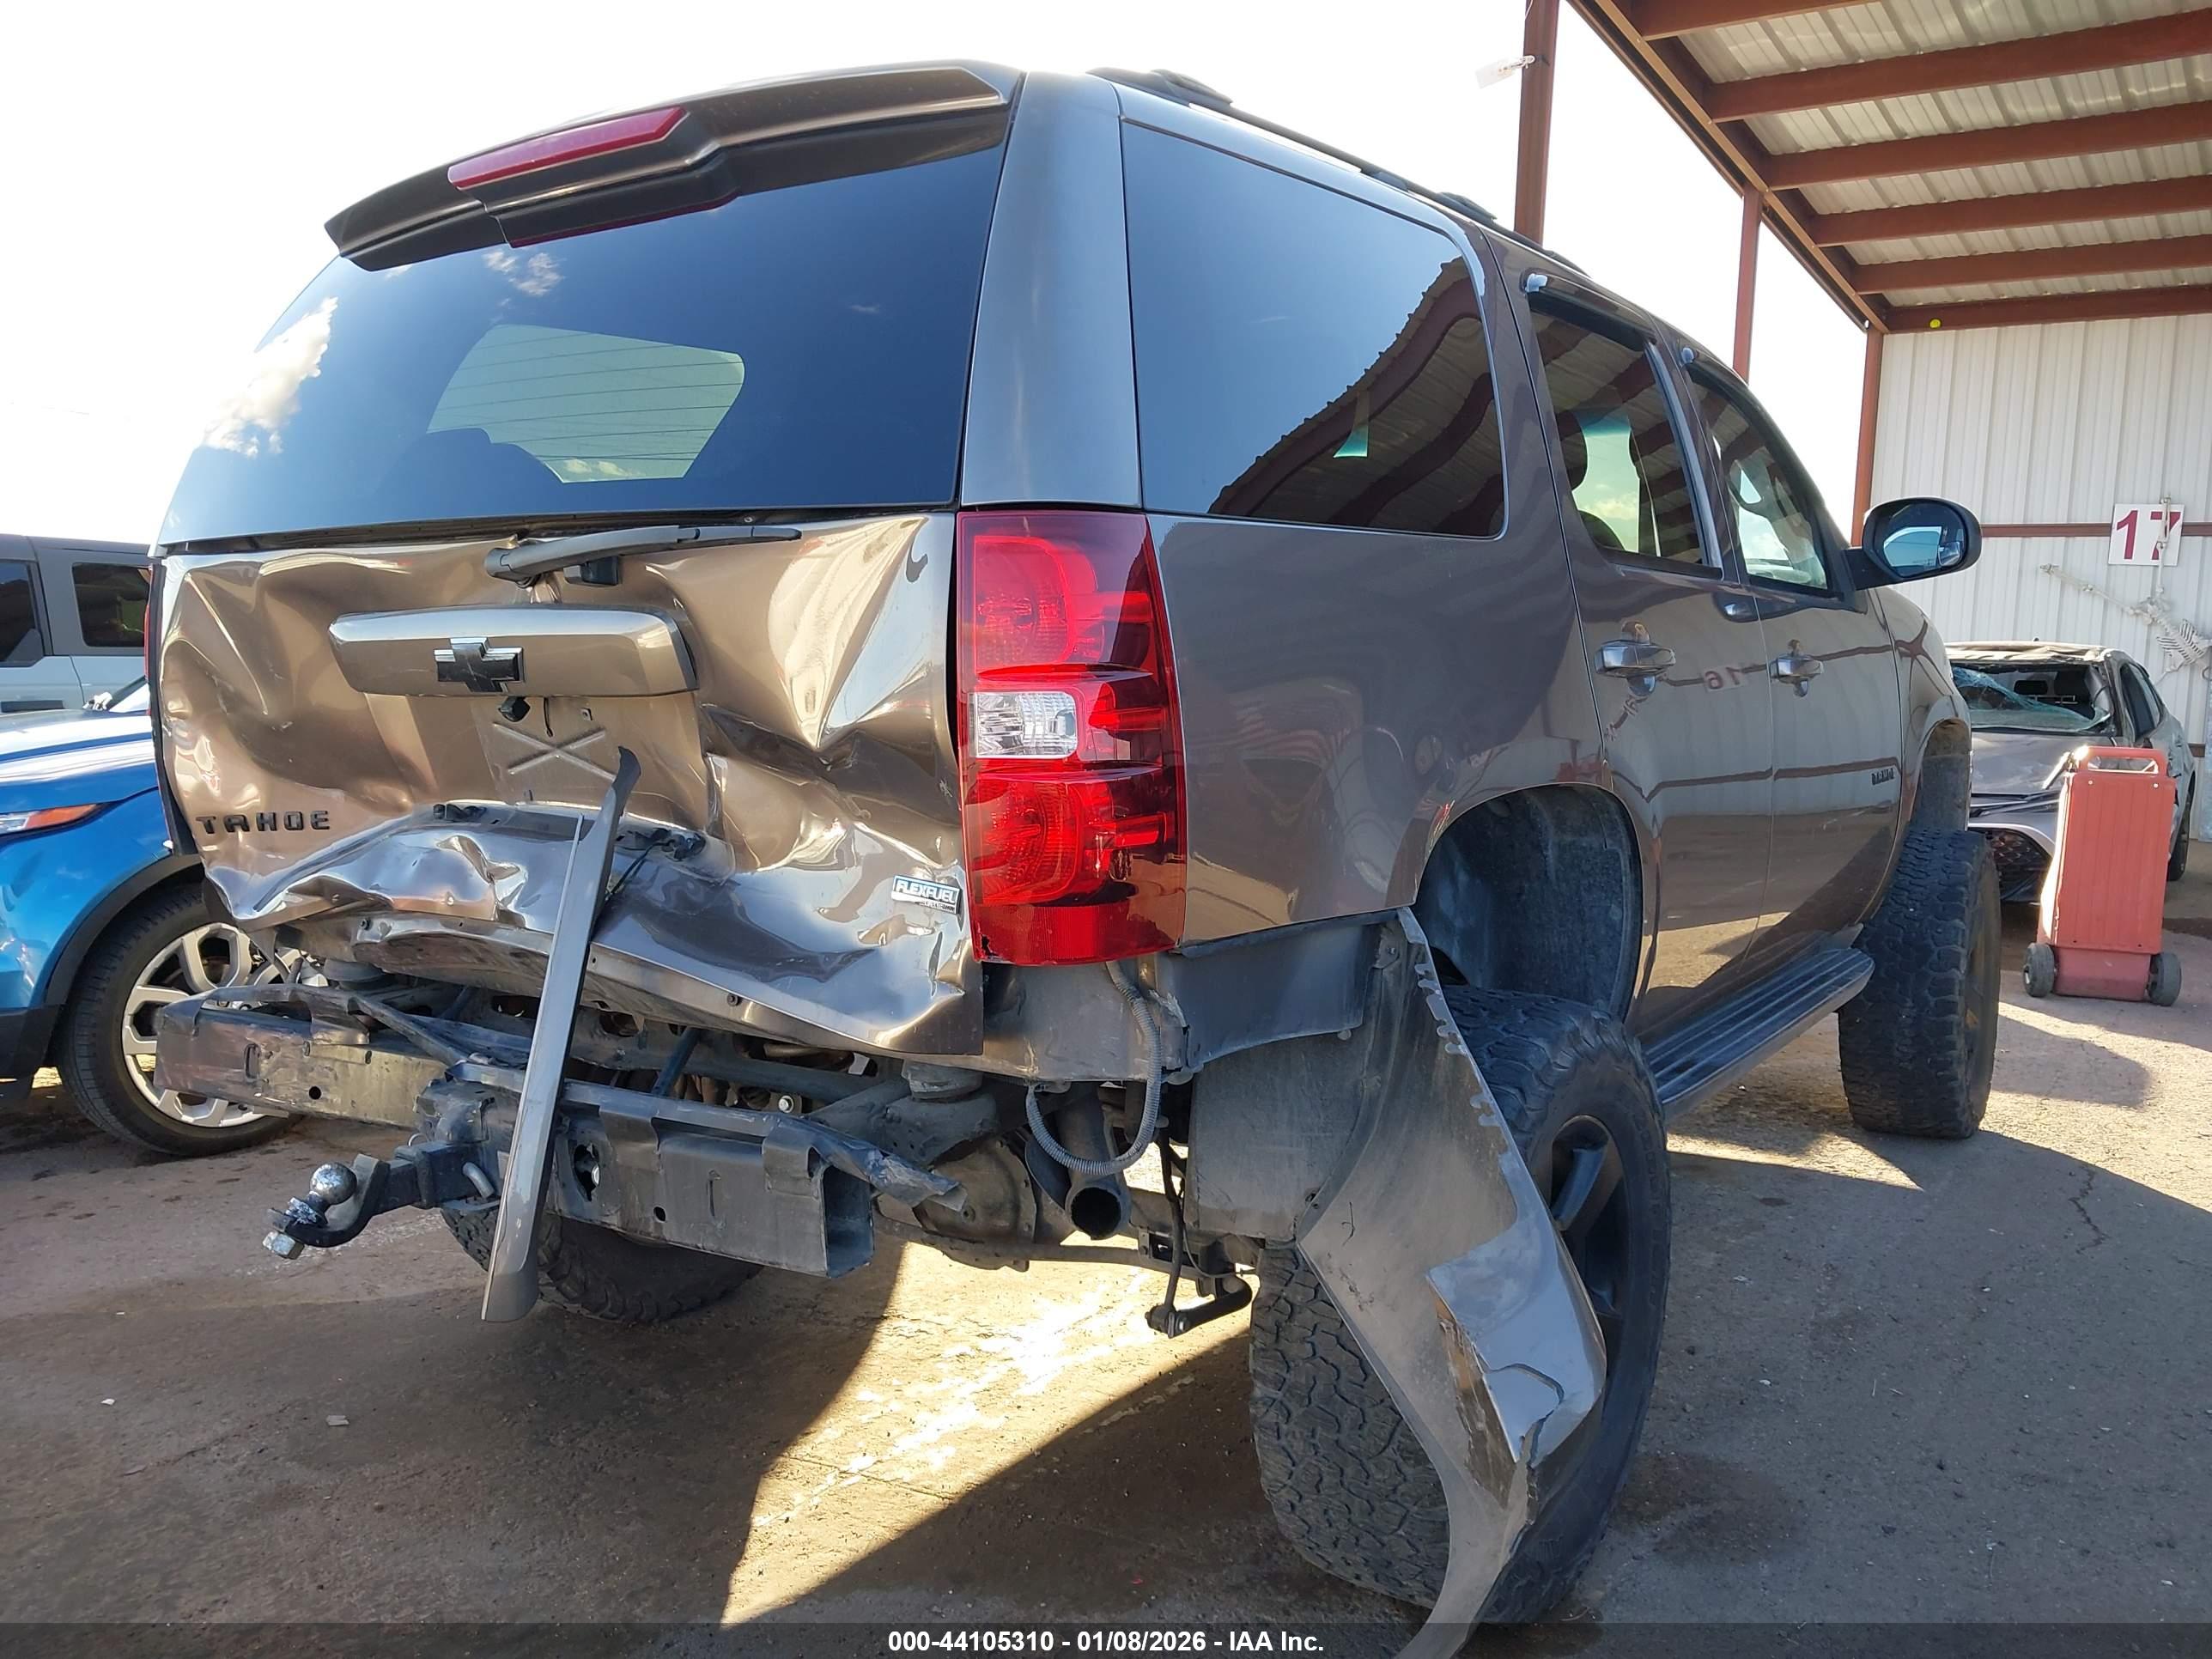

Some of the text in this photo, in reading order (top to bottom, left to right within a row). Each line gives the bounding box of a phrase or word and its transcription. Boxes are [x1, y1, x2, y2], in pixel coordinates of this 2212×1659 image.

[2116, 509, 2182, 561] 17
[195, 810, 331, 835] TAHOE
[895, 878, 956, 903] FLEXFUEL
